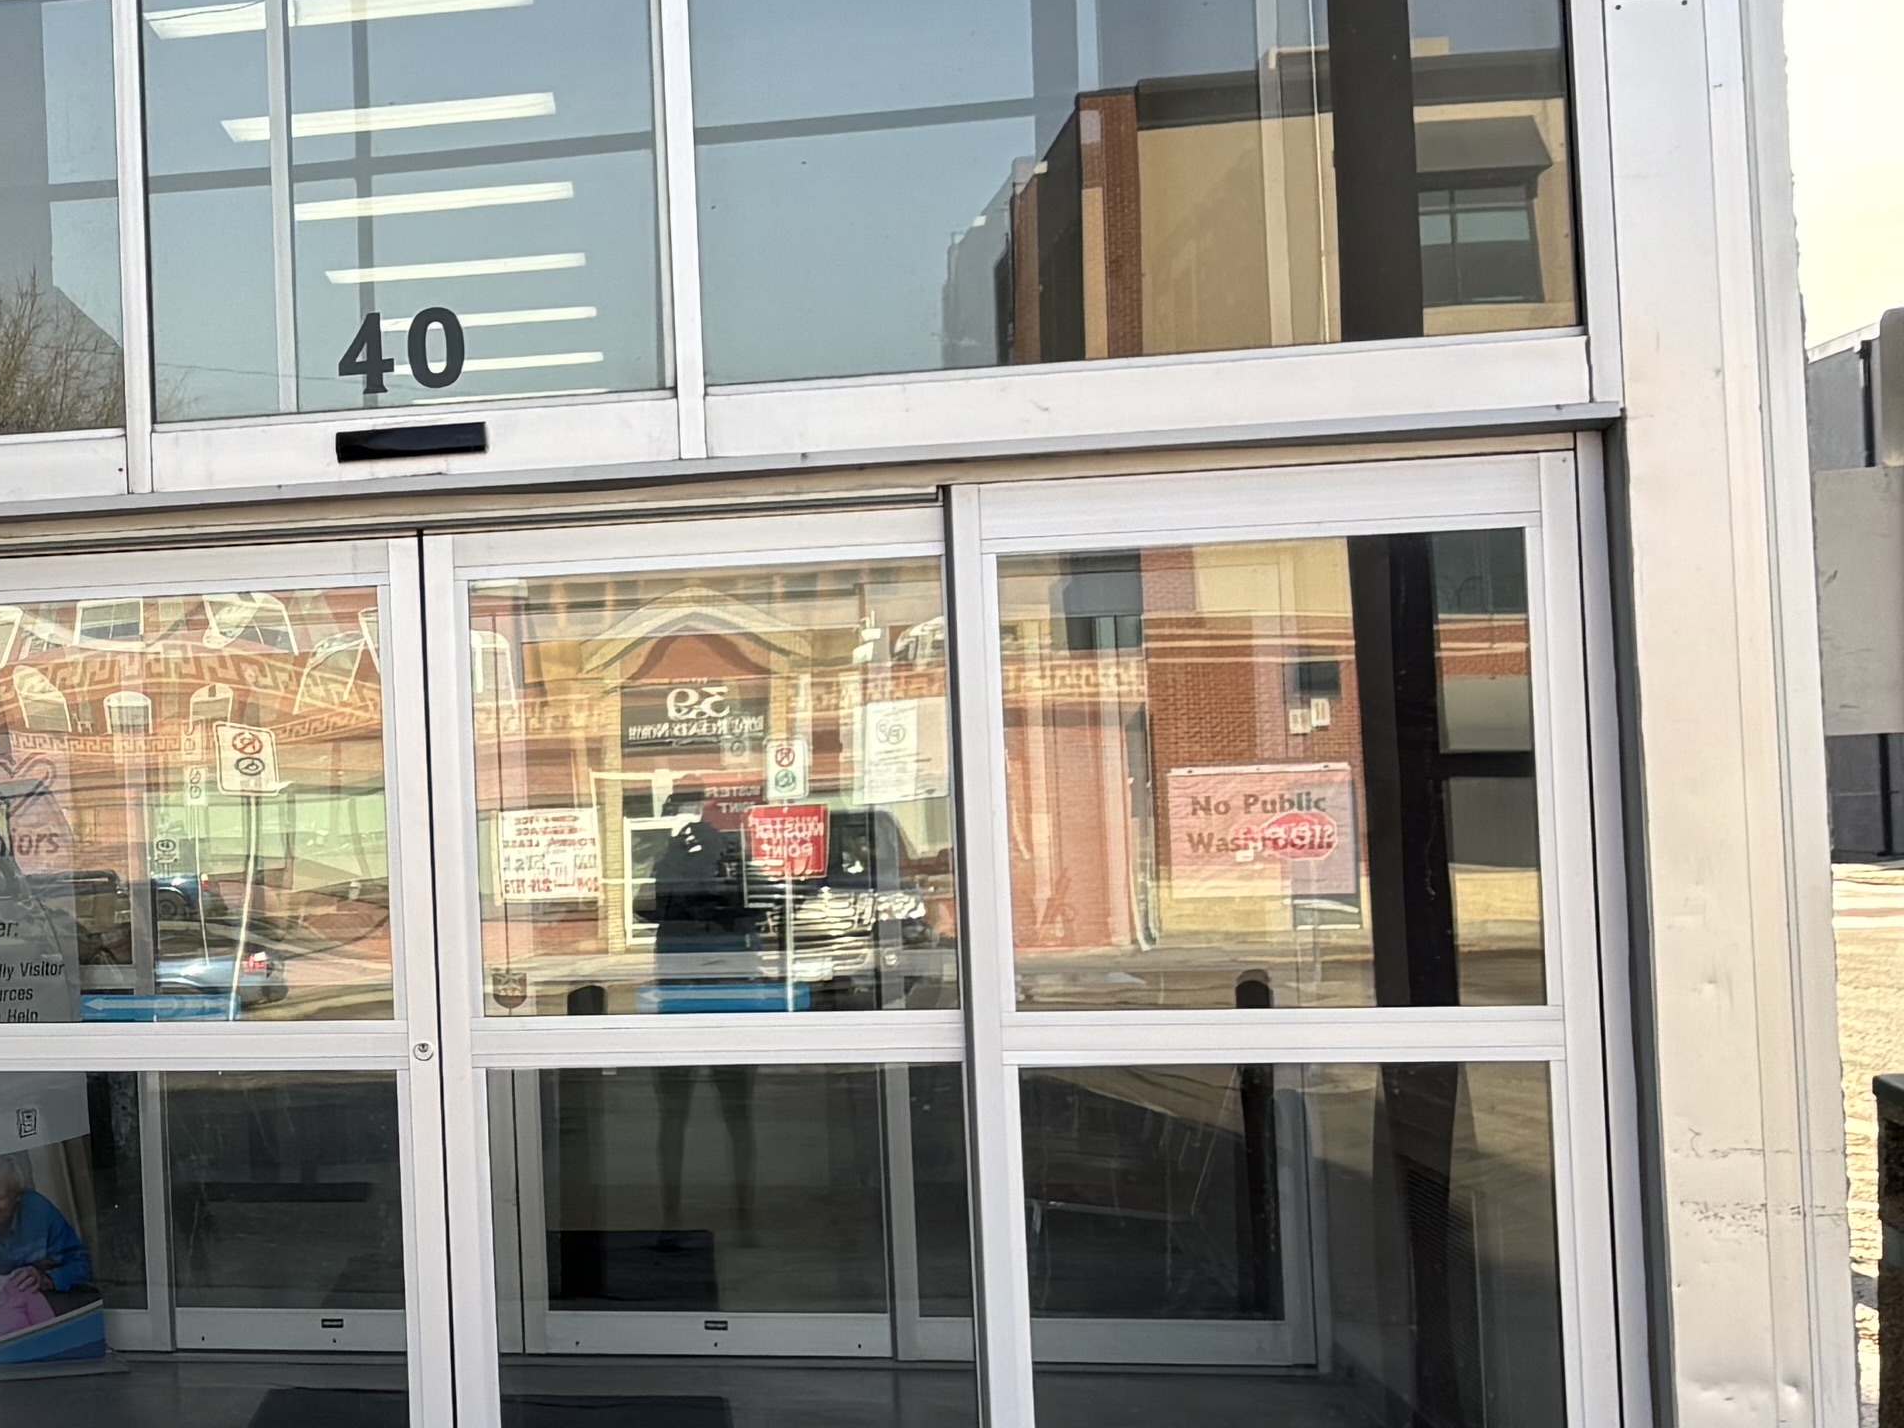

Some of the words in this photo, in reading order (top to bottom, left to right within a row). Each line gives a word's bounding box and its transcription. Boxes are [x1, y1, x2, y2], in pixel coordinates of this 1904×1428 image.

[338, 306, 465, 395] 40
[1191, 795, 1231, 816] No
[1243, 791, 1327, 815] Public
[20, 961, 65, 977] Visitor
